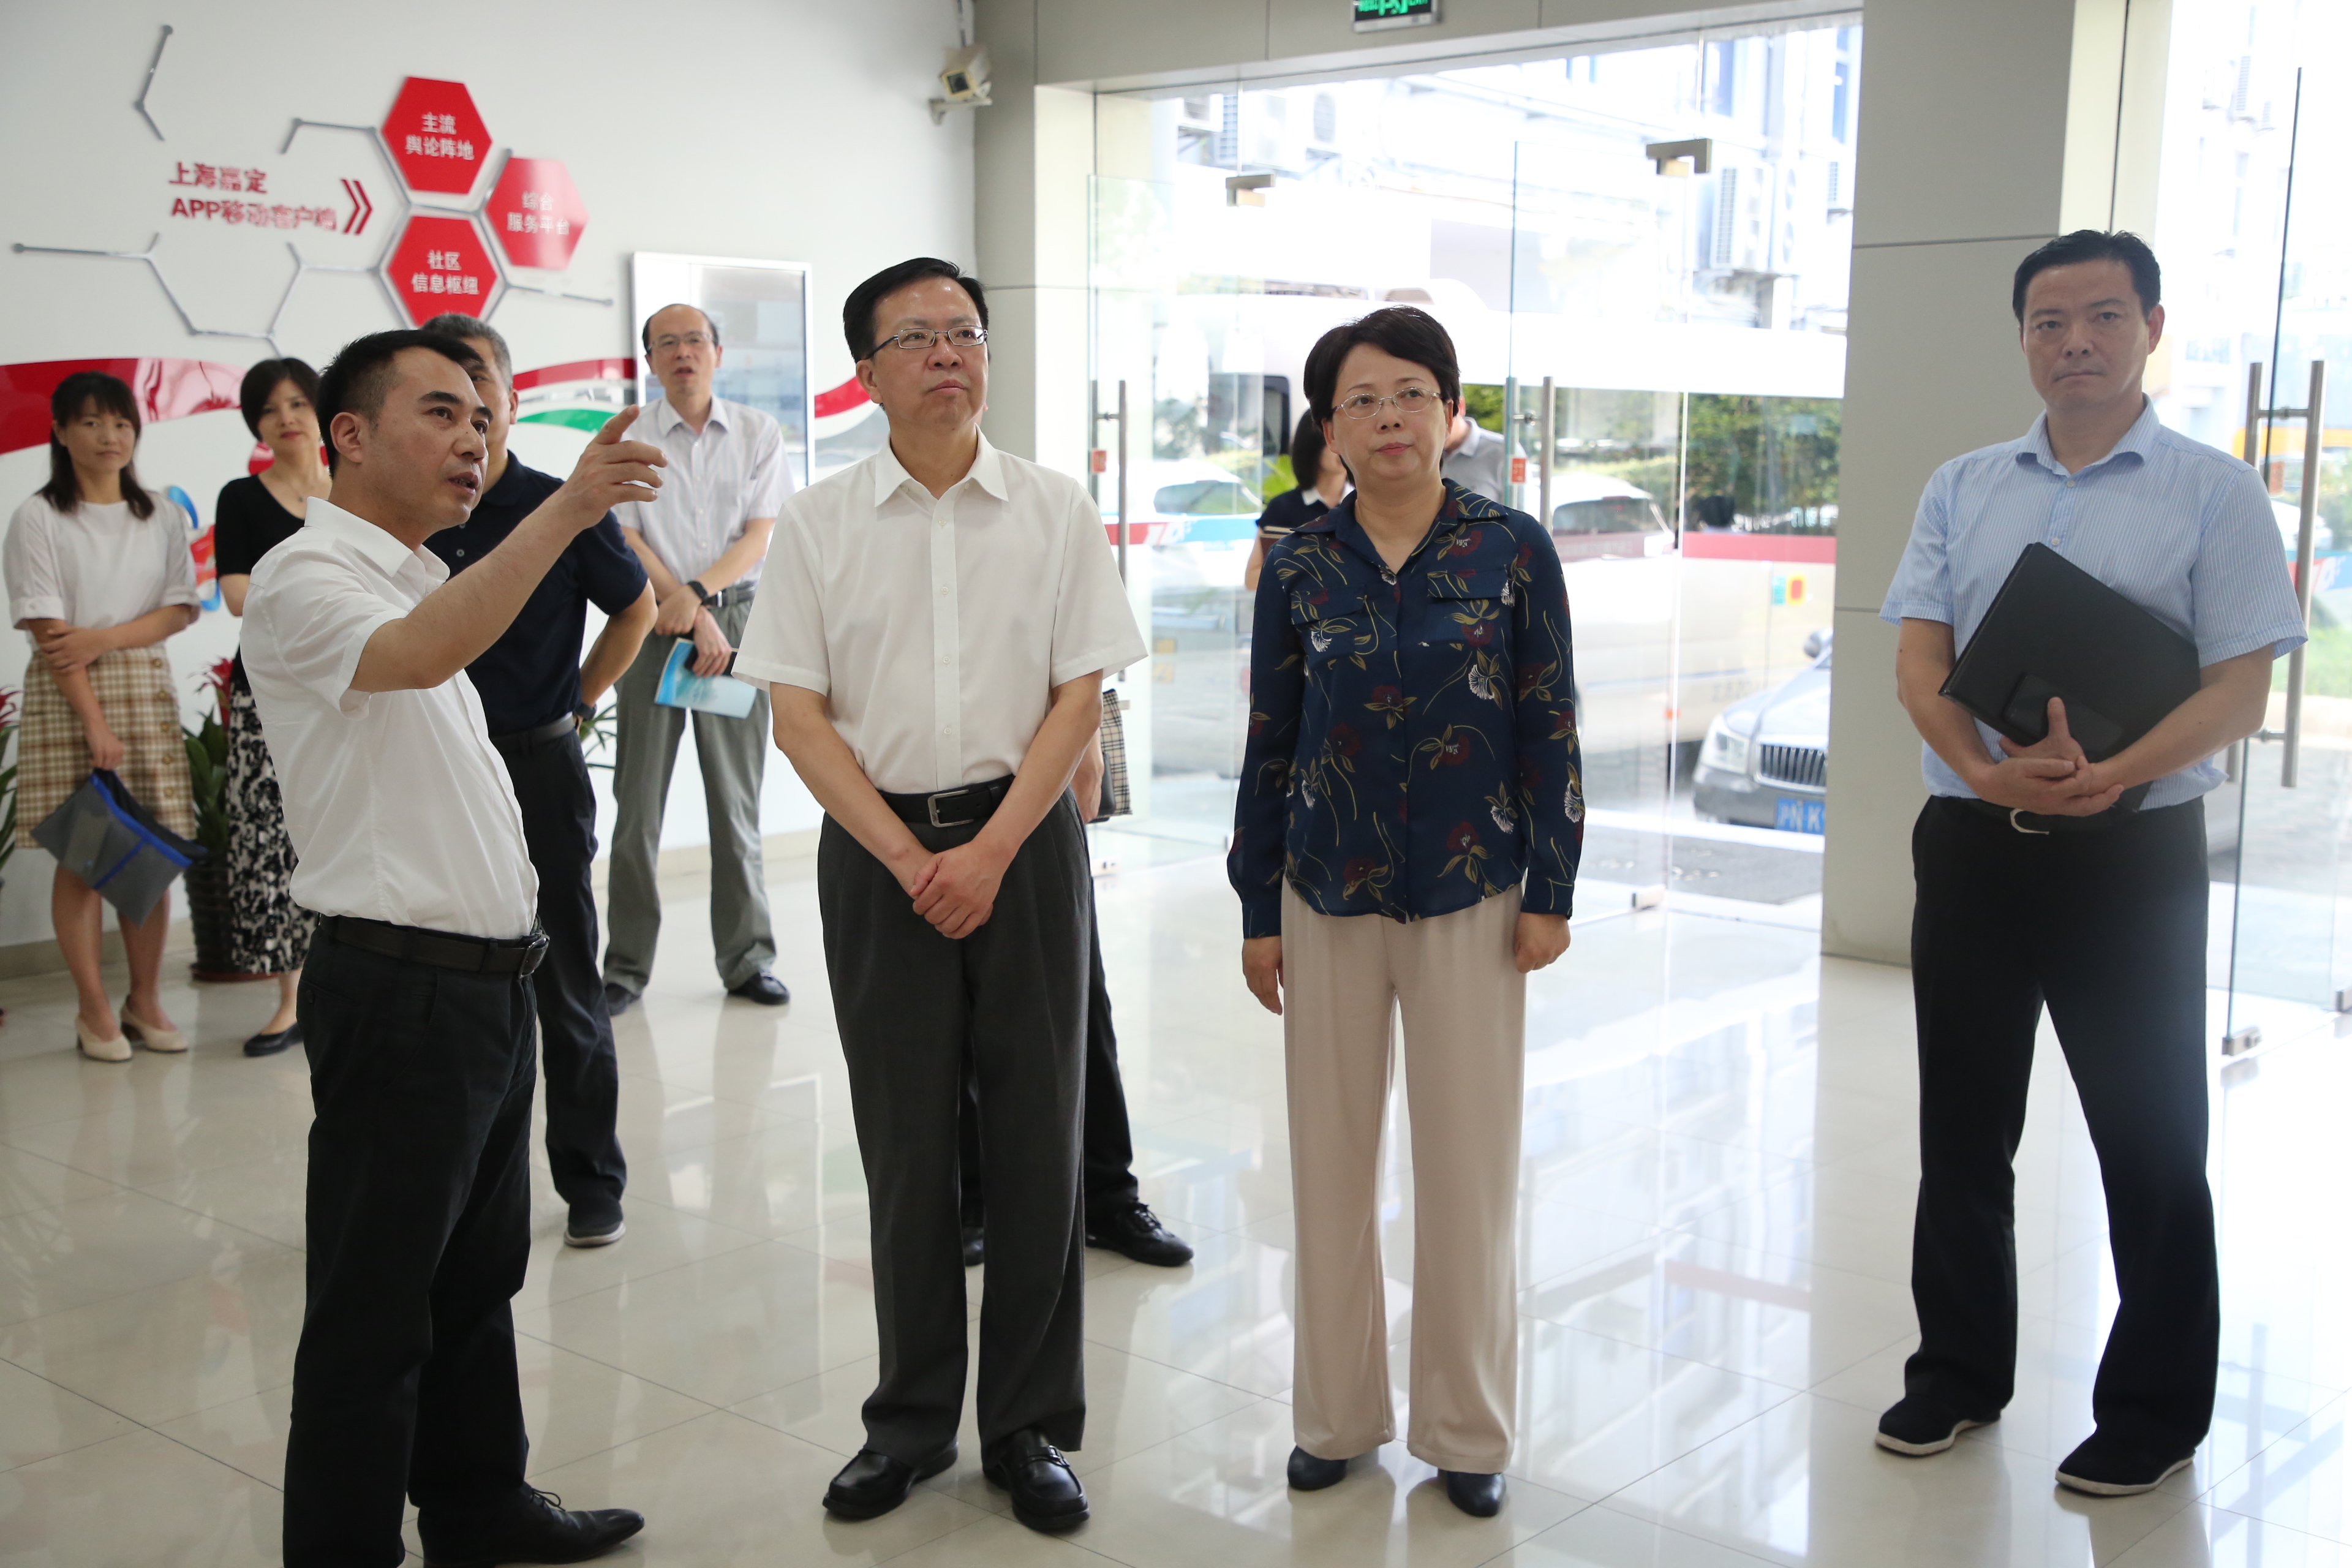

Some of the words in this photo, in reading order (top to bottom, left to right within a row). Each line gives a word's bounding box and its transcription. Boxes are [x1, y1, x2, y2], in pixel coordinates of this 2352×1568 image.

[421, 111, 457, 135] 主流
[405, 134, 475, 160] 舆论阵地
[168, 161, 268, 194] 上海嘉定
[522, 190, 554, 211] 综合
[170, 198, 337, 231] APP移动客户端
[507, 211, 570, 235] 服务平台
[427, 249, 462, 271] 社区
[410, 272, 480, 295] 信息枢纽
